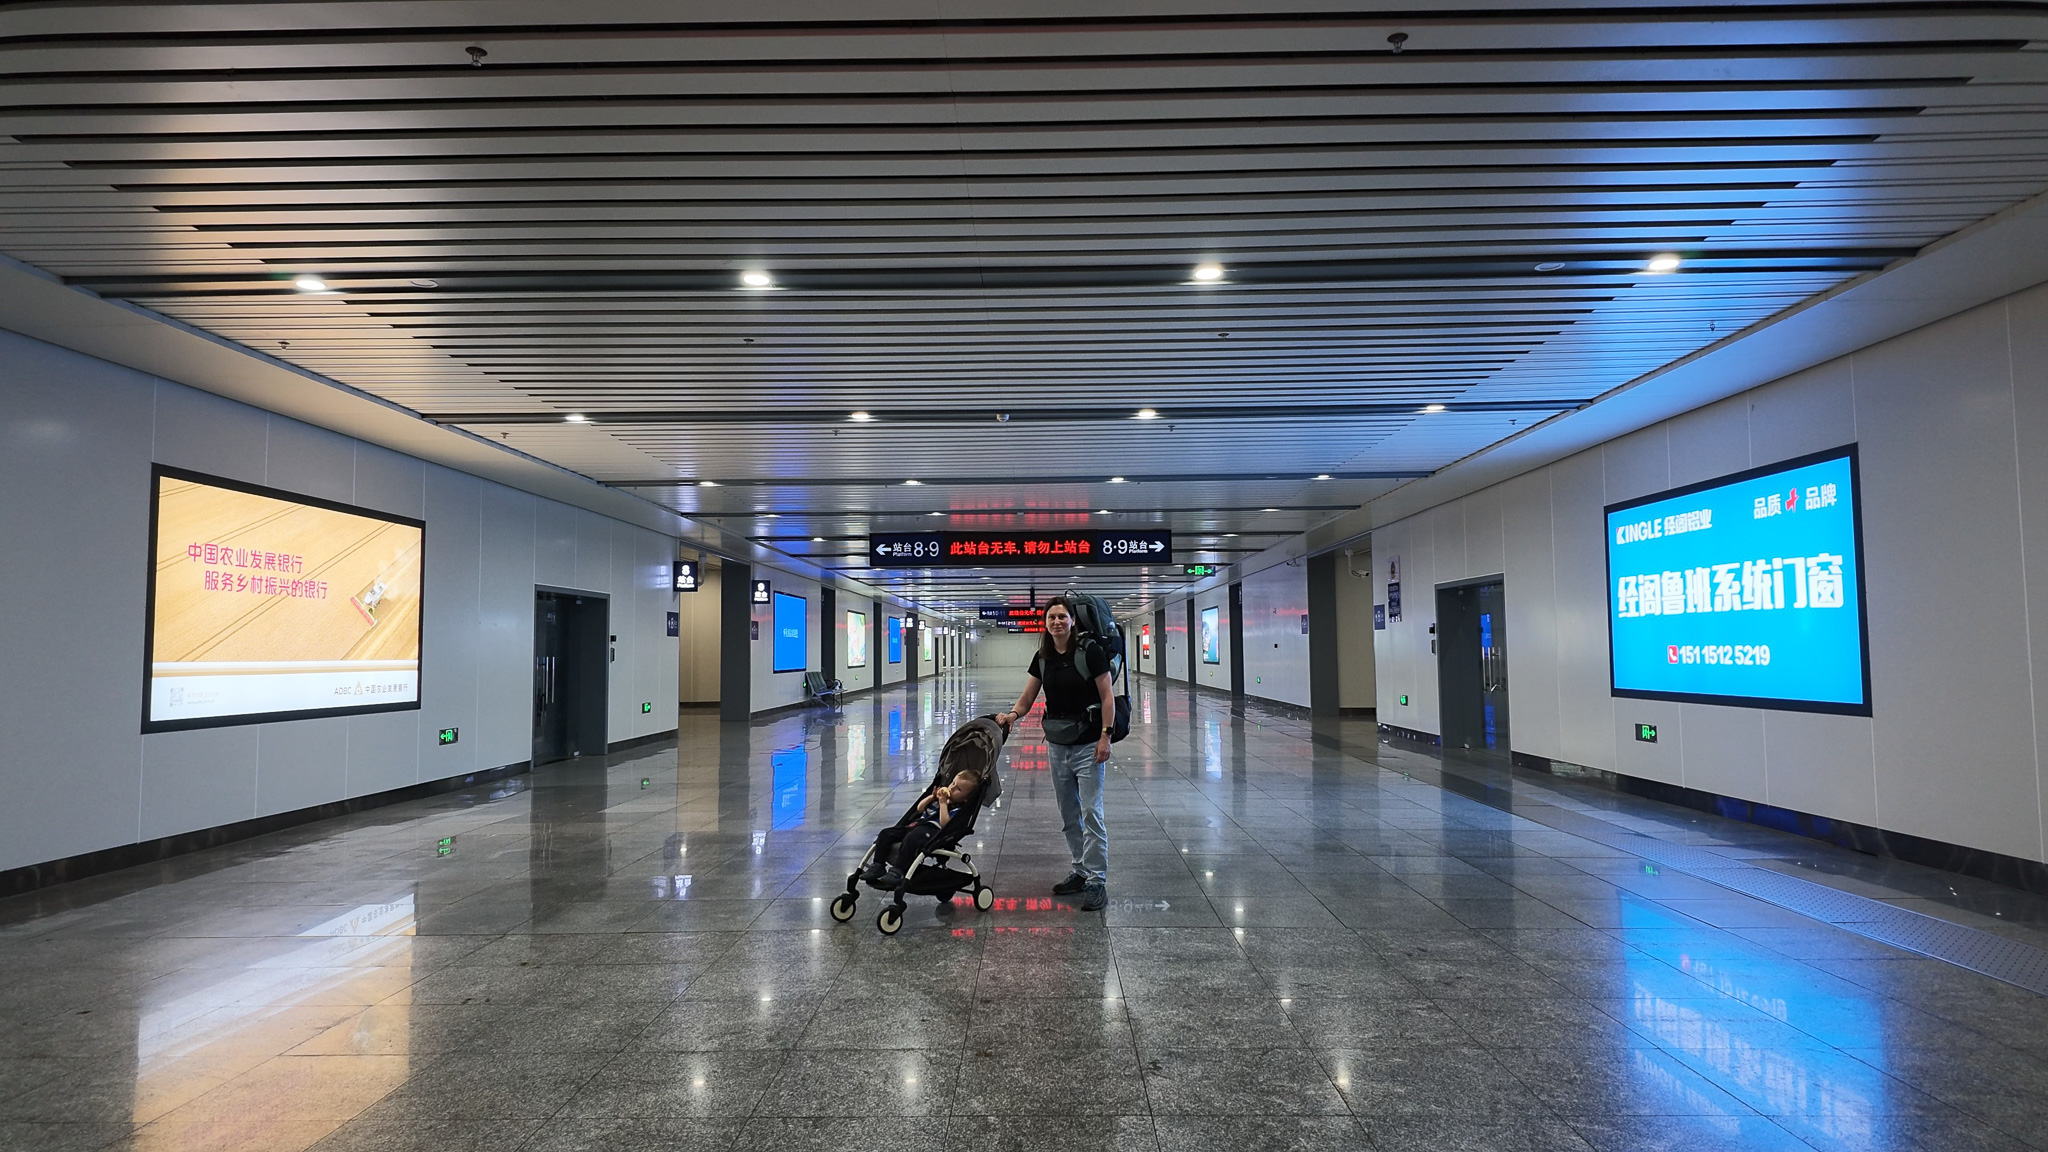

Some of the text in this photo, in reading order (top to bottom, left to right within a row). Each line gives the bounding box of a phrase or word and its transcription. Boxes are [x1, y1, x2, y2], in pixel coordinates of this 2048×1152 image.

[1754, 483, 1837, 519] 品质 品牌
[1616, 518, 1662, 545] KINGLE
[187, 542, 303, 574] 中国农业发展银行
[893, 542, 912, 552] 站台
[1129, 540, 1148, 550] 站台
[682, 565, 690, 575] 8
[204, 570, 328, 599] 服务乡村振兴的银行
[757, 583, 765, 591] 9
[1618, 553, 1844, 618] 经阁鲁班系统门窗
[1679, 644, 1770, 666] 151 1512 5219
